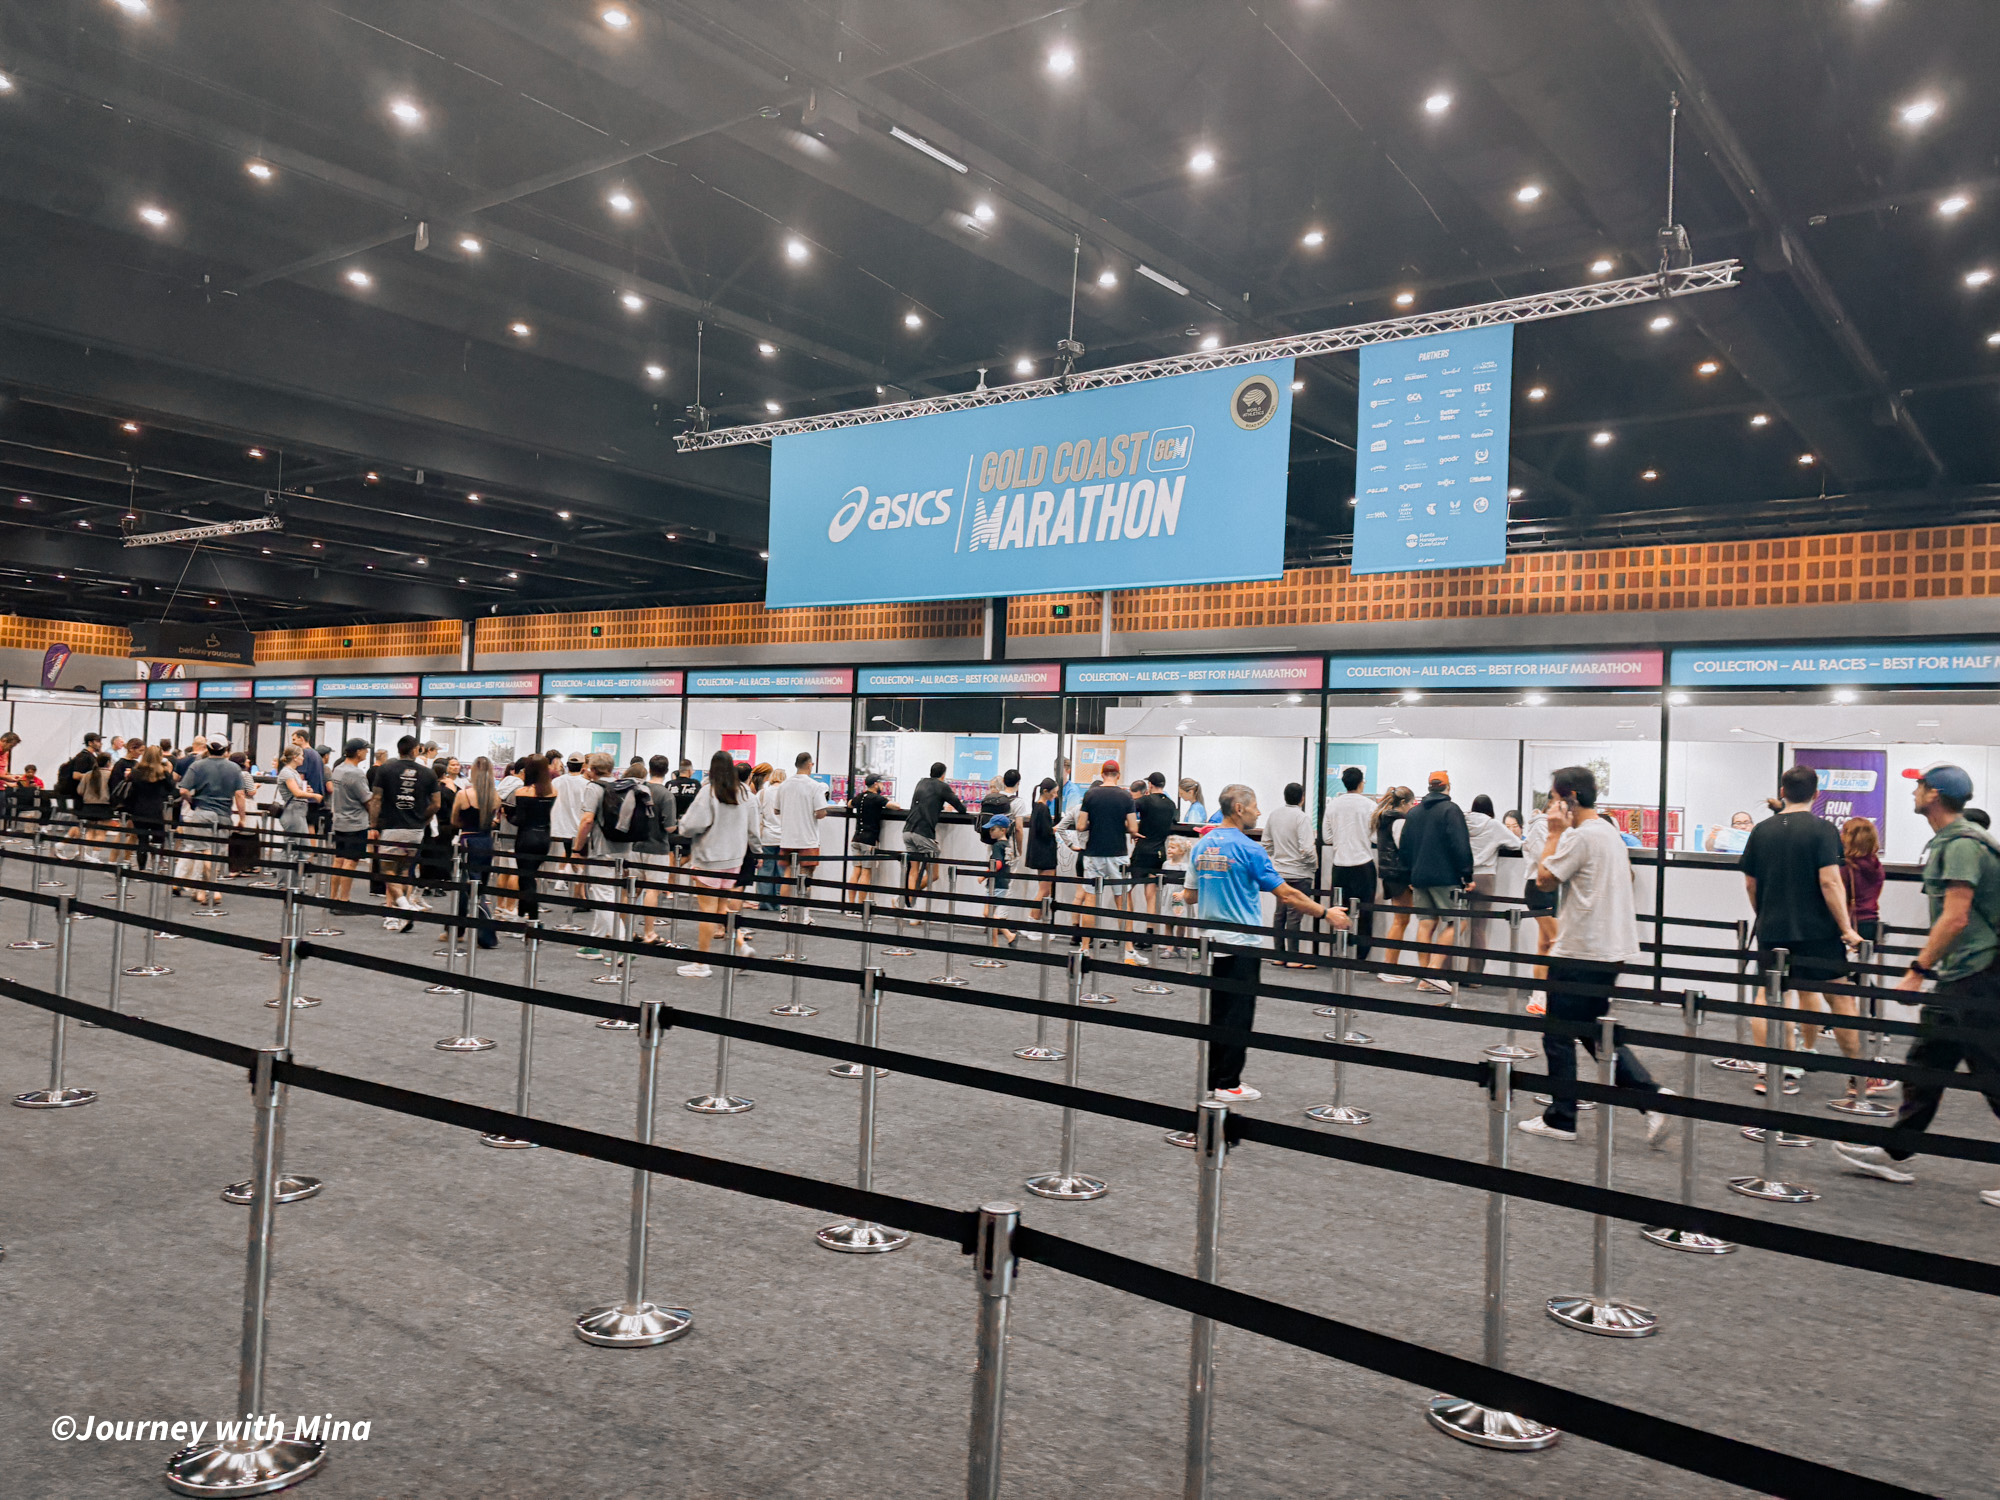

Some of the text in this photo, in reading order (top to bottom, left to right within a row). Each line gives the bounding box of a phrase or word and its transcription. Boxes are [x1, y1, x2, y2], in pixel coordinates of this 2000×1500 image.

[1418, 349, 1450, 362] PARTNERS
[1474, 383, 1492, 392] FIXX
[1154, 436, 1188, 462] GCM
[978, 431, 1149, 492] GOLD COAST
[1439, 456, 1460, 465] goodr
[969, 475, 1186, 552] MARATHON
[1347, 667, 1410, 677] COLLECTION
[1421, 666, 1439, 676] ALL
[1441, 665, 1476, 676] RACES
[1489, 665, 1512, 675] BEST
[1514, 664, 1537, 675] FOR
[1540, 664, 1568, 674] HALF
[1570, 662, 1641, 674] MARATHON
[1694, 660, 1777, 673] COLLECTION
[1791, 659, 1816, 671] ALL
[1819, 658, 1866, 671] RACES
[1883, 658, 1914, 670] BEST
[1918, 657, 1948, 669] FOR
[1952, 657, 1992, 668] HALF
[697, 678, 734, 686] COLLECTION
[739, 678, 749, 686] ALL
[750, 678, 770, 686] RACES
[776, 677, 789, 686] BEST
[790, 677, 804, 685] FOR
[804, 677, 843, 685] MARATHON
[870, 676, 914, 685] COLLECTION
[921, 675, 933, 684] ALL
[934, 675, 958, 684] RACES
[965, 674, 982, 683] BEST
[983, 674, 998, 683] FOR
[999, 673, 1047, 683] MARATHON
[1079, 672, 1129, 682] COLLECTION
[1136, 672, 1150, 681] ALL
[1152, 672, 1179, 681] RACES
[1189, 670, 1207, 680] BEST
[1208, 670, 1226, 679] FOR
[1228, 670, 1251, 679] HALF
[1251, 669, 1307, 679] MARATHON
[642, 678, 675, 687] MARATHON
[1825, 801, 1852, 815] RUN
